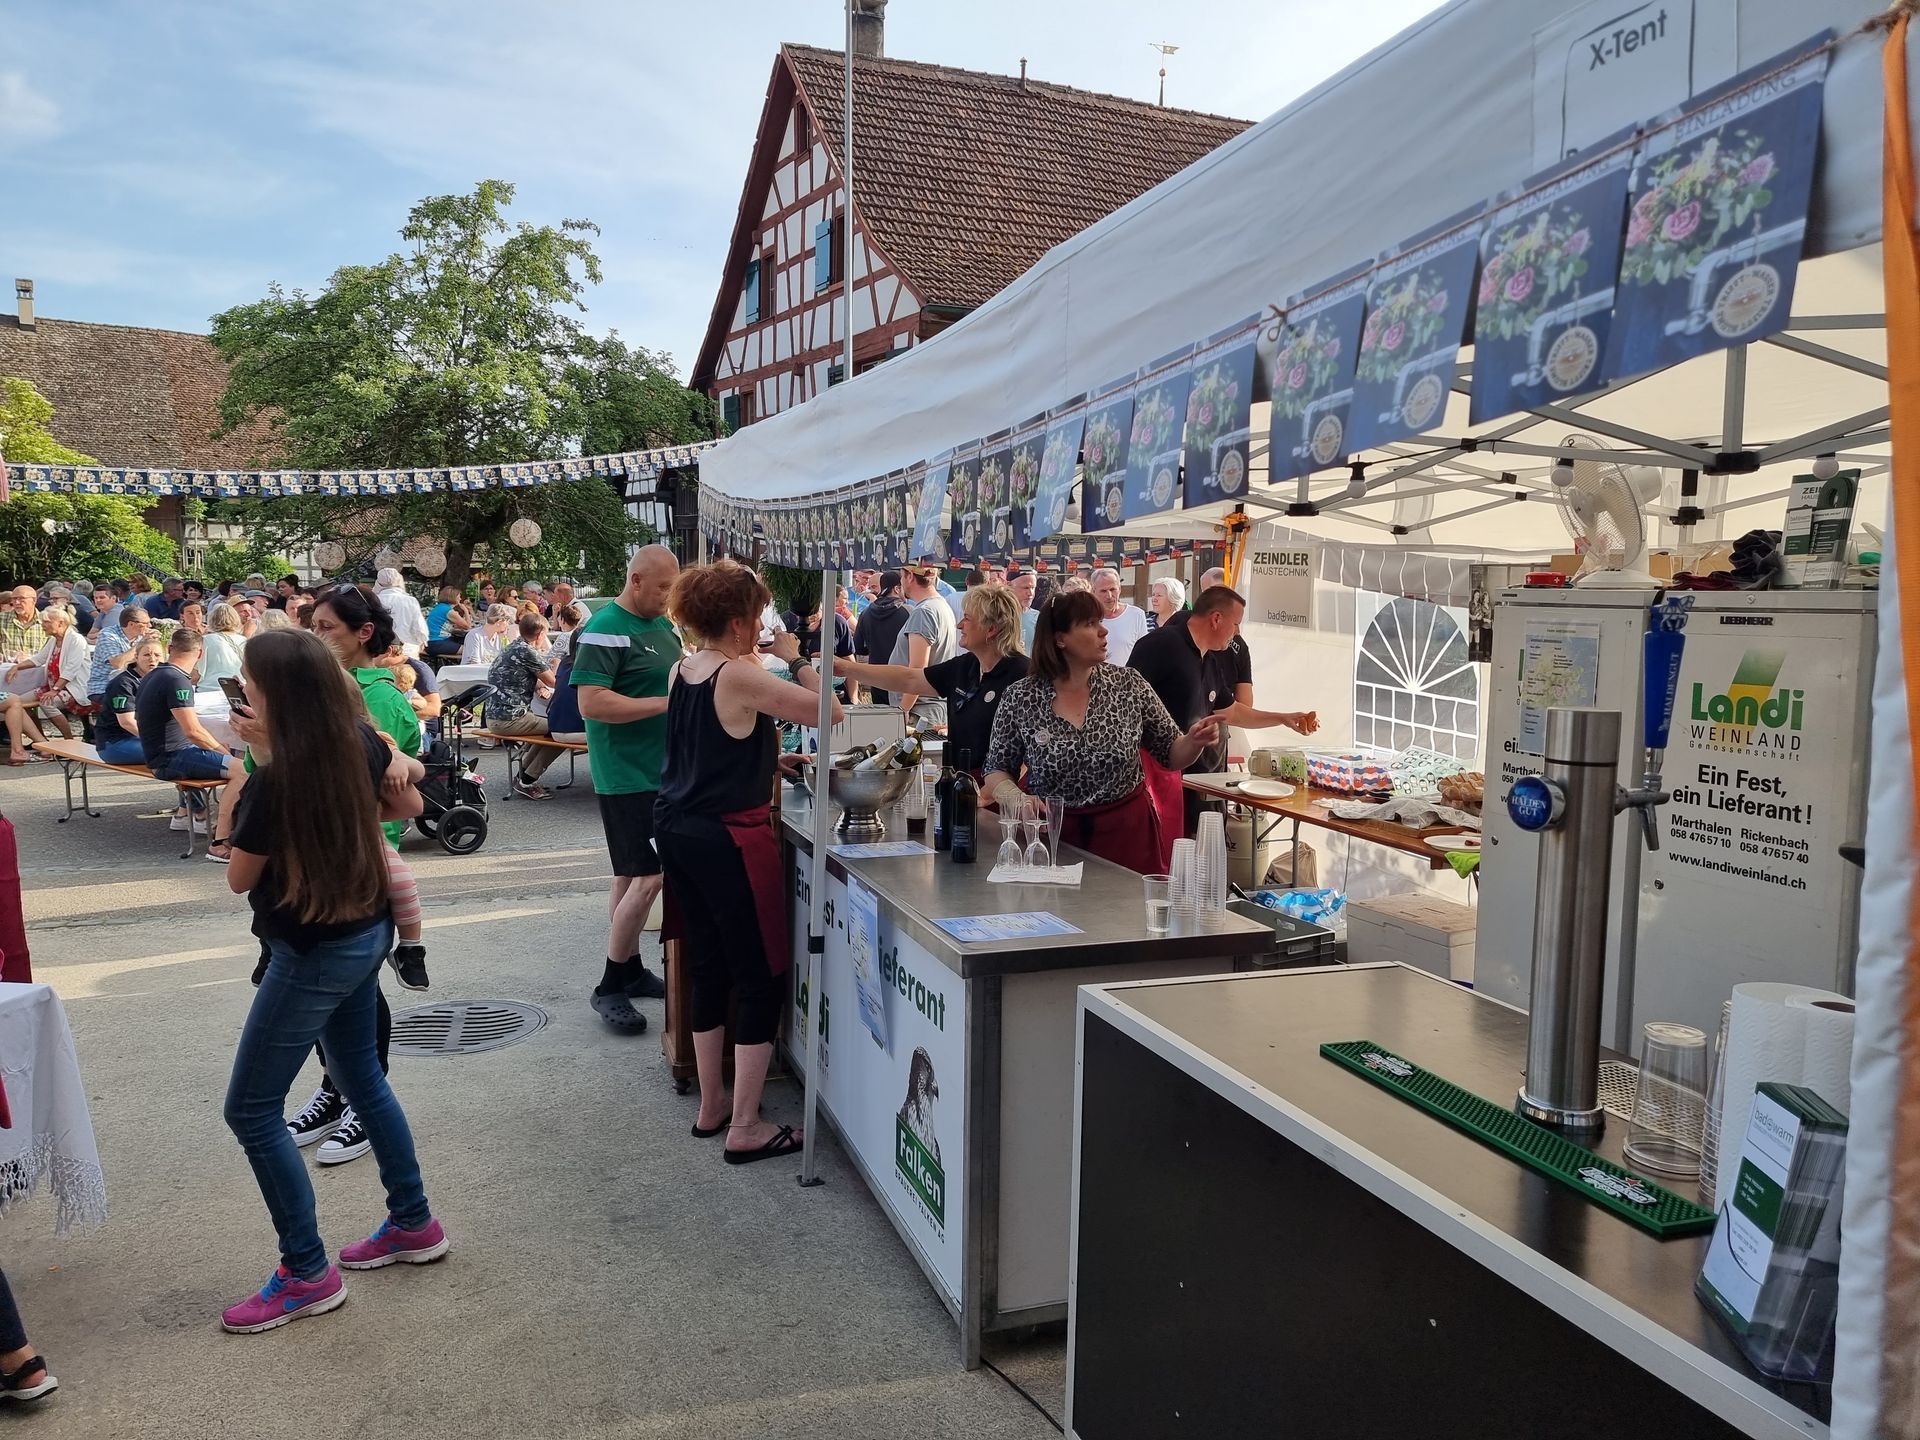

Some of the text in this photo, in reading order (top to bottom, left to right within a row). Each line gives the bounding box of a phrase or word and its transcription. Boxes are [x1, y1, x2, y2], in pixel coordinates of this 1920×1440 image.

[1590, 9, 1667, 71] X-Tent
[1252, 566, 1309, 577] HAUSTECHNIK
[1253, 552, 1309, 566] ZEINDLER
[1719, 616, 1774, 626] LIEBHERR
[1663, 652, 1680, 716] HALDENGUT
[1691, 682, 1805, 731] Landi
[1689, 740, 1800, 762] Genossenschaft
[1690, 725, 1801, 751] WEINLAND
[1672, 785, 1702, 806] ein
[1697, 763, 1787, 798] Ein Fest,
[1511, 795, 1547, 809] HALDEN
[1518, 805, 1538, 816] GUT
[1670, 828, 1687, 840] 058
[1671, 813, 1809, 851] Marthalen Rickenbach
[1740, 841, 1759, 854] 058
[1669, 851, 1807, 890] www.landiweinland.ch
[796, 866, 811, 907] Ein
[879, 935, 946, 1033] ieferant
[900, 1128, 941, 1208] Falken
[894, 1168, 918, 1206] BRAUEREI
[918, 1201, 937, 1233] FALKEN
